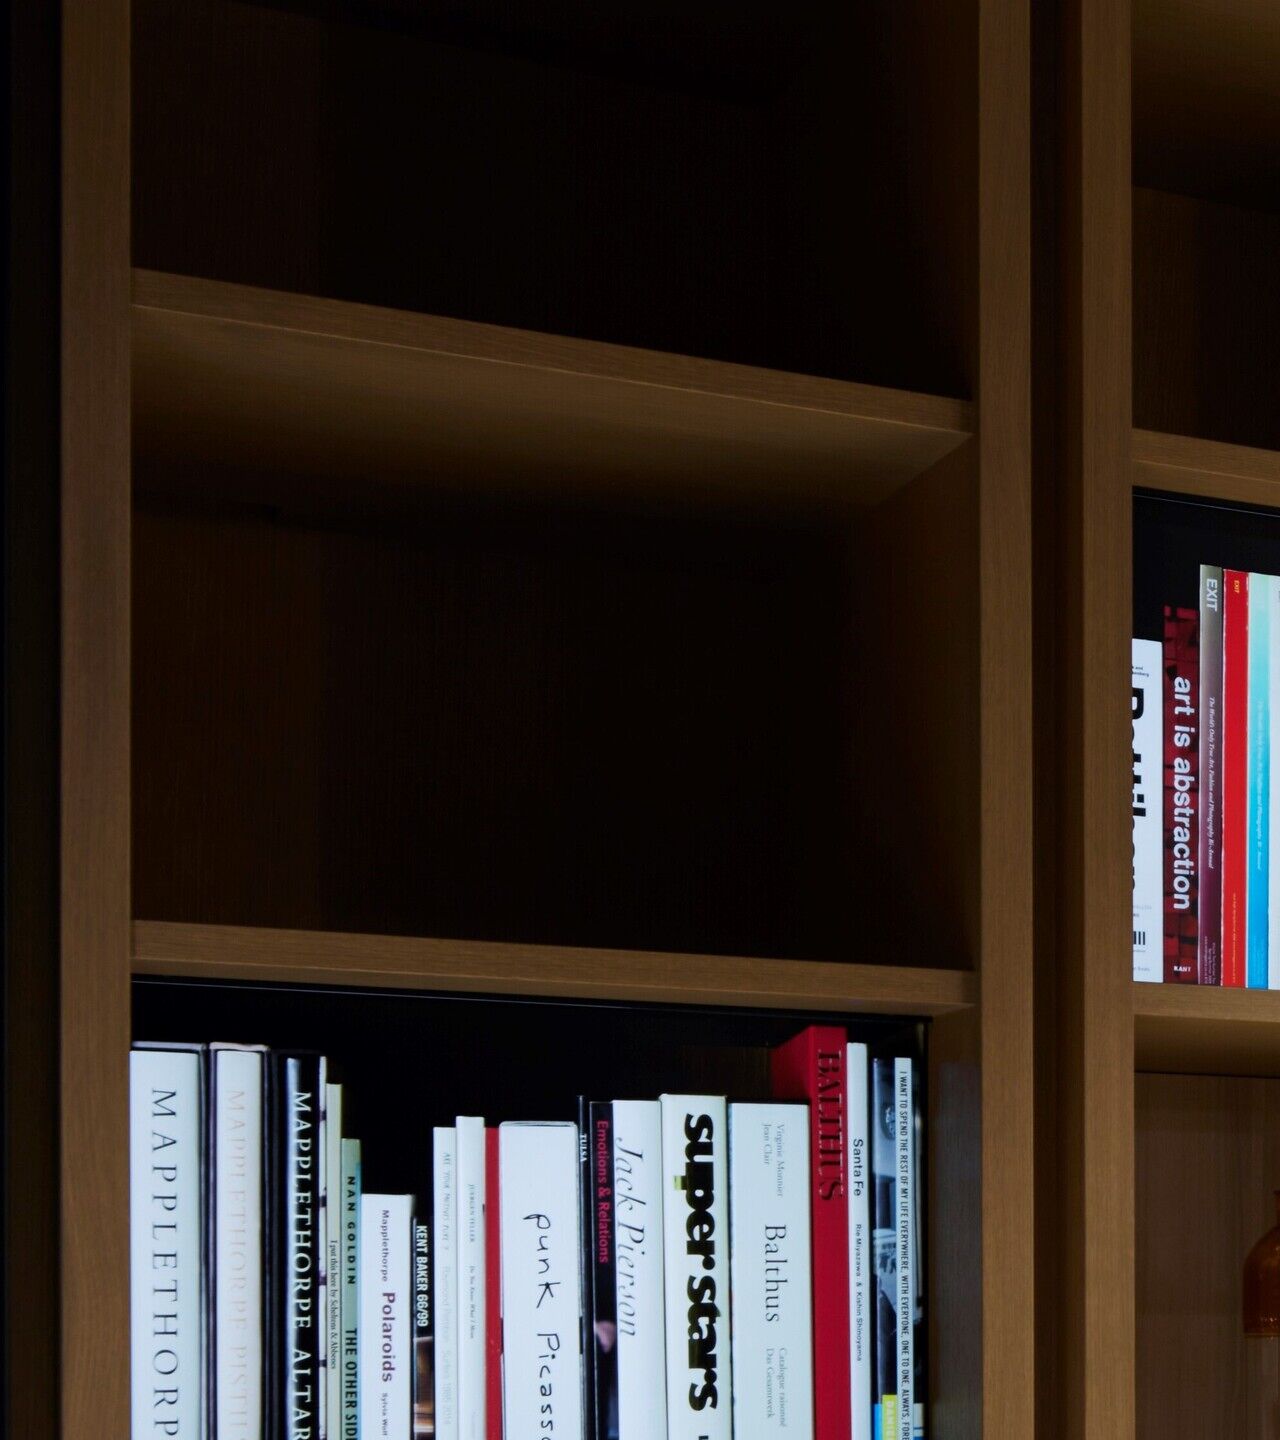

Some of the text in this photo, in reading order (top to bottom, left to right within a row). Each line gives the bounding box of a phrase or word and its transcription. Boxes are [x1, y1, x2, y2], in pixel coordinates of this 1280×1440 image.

[1206, 578, 1217, 611] EXIT
[1172, 676, 1195, 910] art is abstraction
[899, 1075, 908, 1097] WANT
[900, 1098, 908, 1108] TO
[816, 1050, 843, 1201] BALTHUS
[900, 1110, 908, 1135] SPEND
[900, 1137, 908, 1152] THE
[597, 1120, 611, 1183] Emotions
[853, 1138, 864, 1196] Santa Fe
[900, 1154, 908, 1174] REST
[900, 1175, 908, 1186] OF
[900, 1188, 908, 1200] MY
[224, 1090, 248, 1330] MAPPLETHORPE
[291, 1091, 312, 1329] MAPPLETHORPE
[347, 1176, 356, 1285] NAN GOLDIN
[597, 1202, 611, 1263] Relations
[900, 1201, 908, 1218] LIFE
[380, 1209, 391, 1282] Mapplethorpe
[524, 1214, 561, 1308] punk
[615, 1137, 645, 1337] Jack Pierson
[900, 1220, 909, 1272] EVERYWHERE,
[417, 1225, 429, 1327] KENT BAKER 66/99
[684, 1113, 719, 1411] super stars
[764, 1224, 787, 1322] Balthus
[901, 1274, 909, 1294] WITH
[381, 1291, 396, 1382] Polaroids
[901, 1296, 909, 1338] EVERYONE,
[345, 1328, 358, 1356] THE
[901, 1340, 909, 1355] ONE
[901, 1356, 909, 1367] TO
[345, 1359, 358, 1408] OTHER
[901, 1369, 910, 1386] ONE,
[901, 1388, 910, 1418] ALWAYS,
